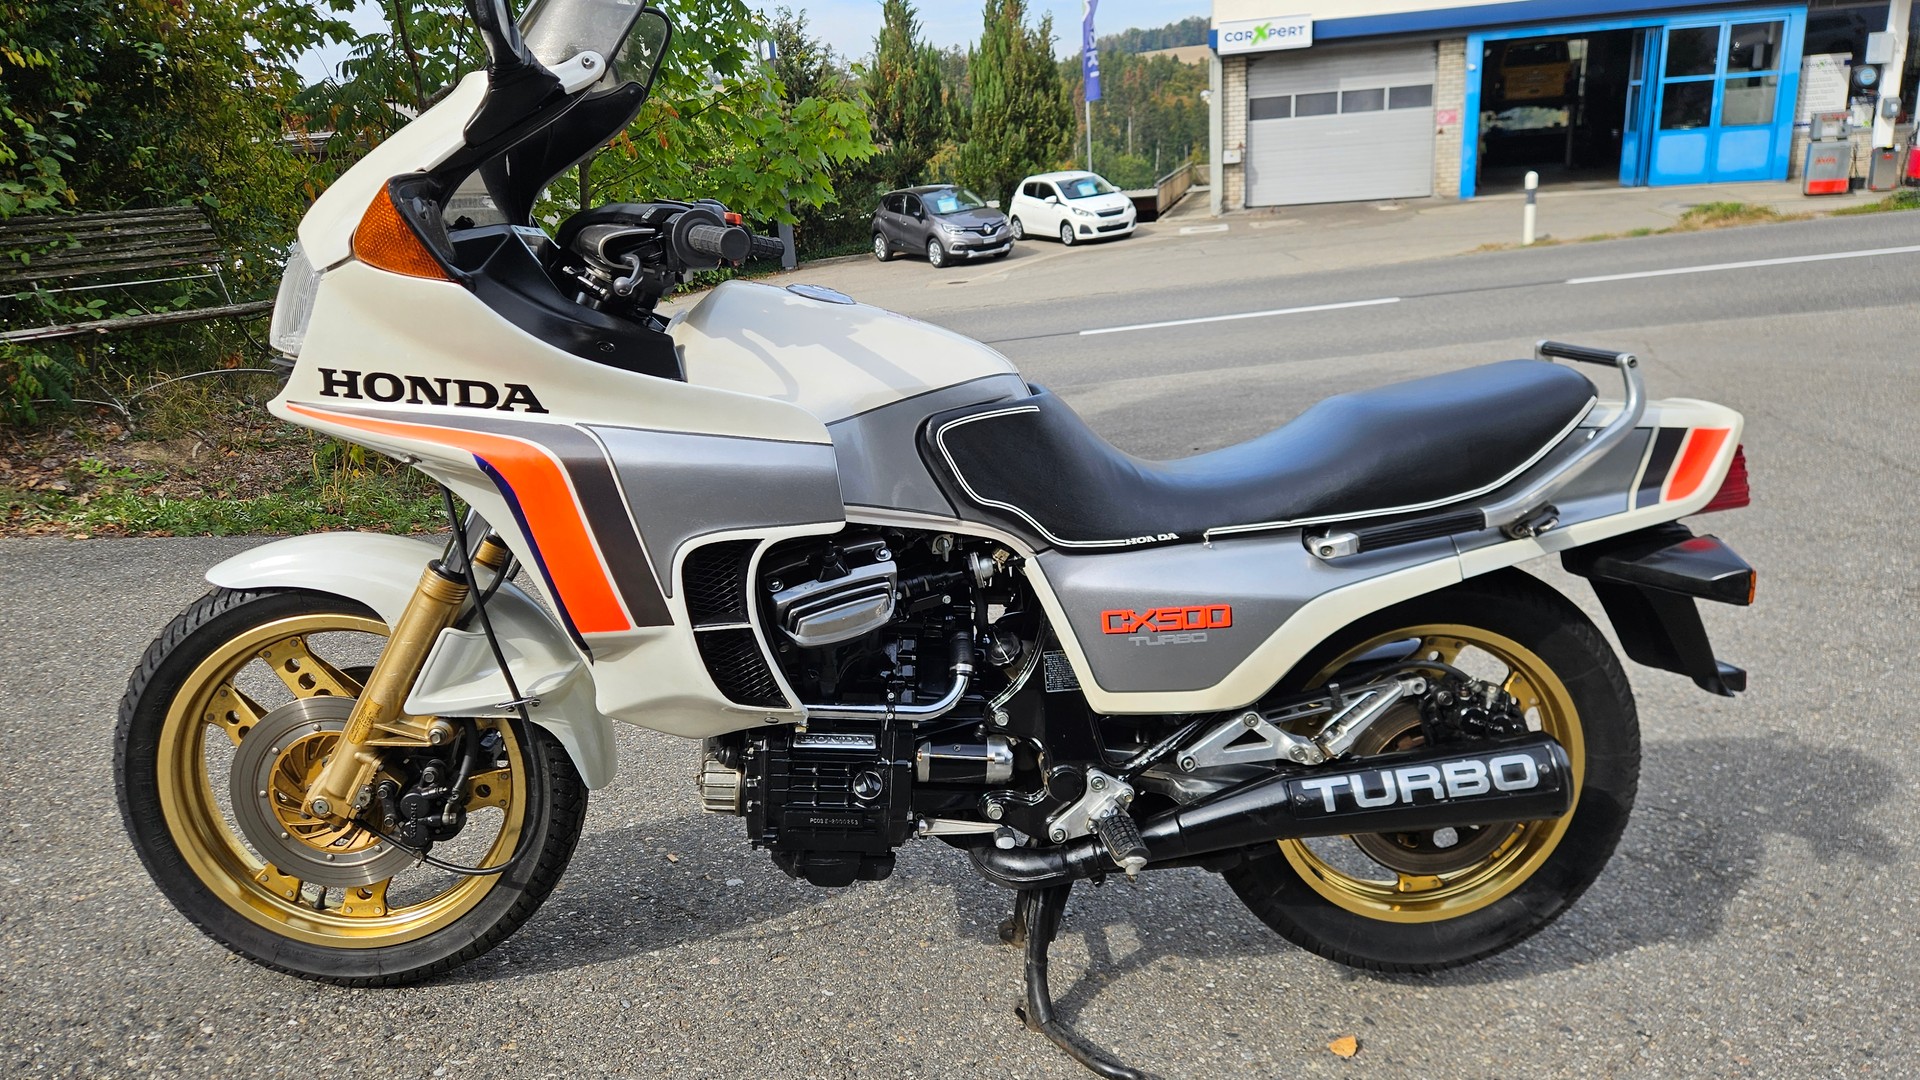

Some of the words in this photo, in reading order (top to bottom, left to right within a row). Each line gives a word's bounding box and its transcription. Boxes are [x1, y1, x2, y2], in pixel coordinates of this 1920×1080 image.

[318, 367, 549, 414] HONDA
[1101, 604, 1232, 634] CX500
[1128, 633, 1208, 646] TURBO
[1301, 753, 1539, 813] TURBO
